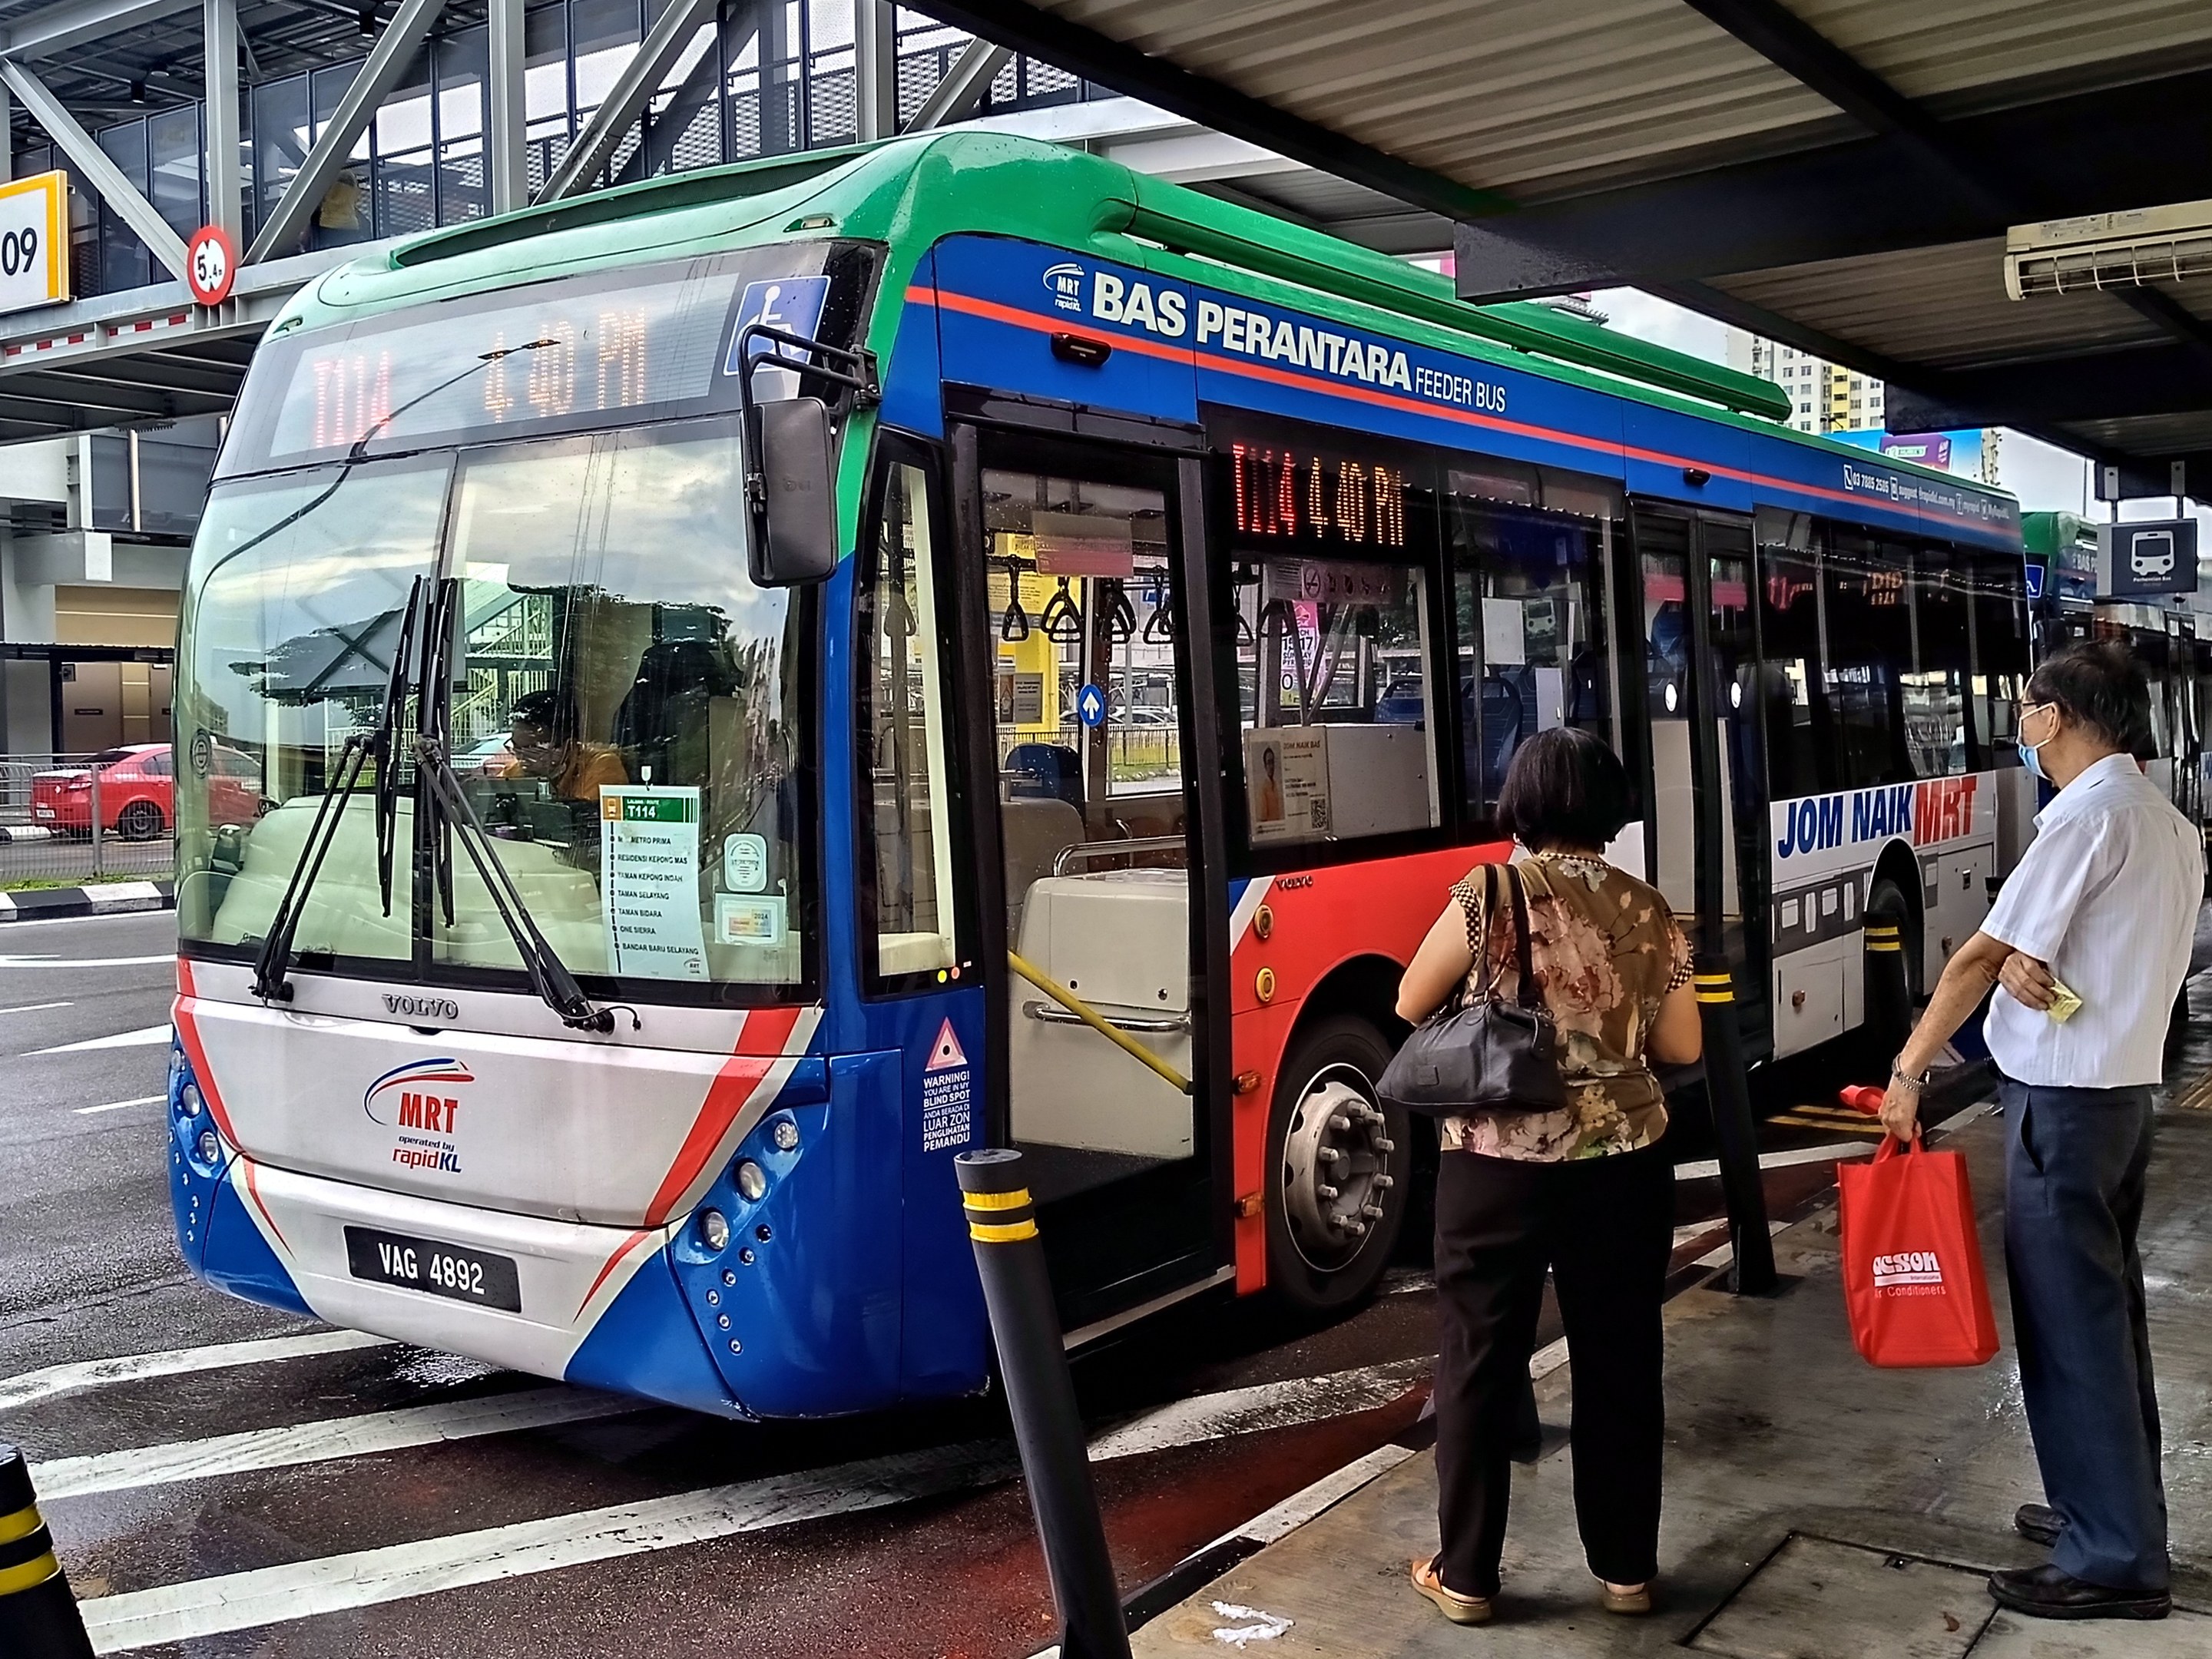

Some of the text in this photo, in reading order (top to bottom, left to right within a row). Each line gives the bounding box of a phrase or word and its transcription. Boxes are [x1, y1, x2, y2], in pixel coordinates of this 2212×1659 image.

[2, 227, 38, 276] 09
[1057, 276, 1080, 296] MRT
[1093, 271, 1506, 413] BAS PERANTARA FEEDER BUS
[313, 349, 391, 449] T114
[1233, 445, 1296, 536] T114
[627, 805, 656, 818] T114
[1777, 775, 1978, 859] JOM NAIK MRT
[631, 836, 651, 844] METRO
[652, 836, 671, 845] PRIMA
[618, 853, 688, 865] RESIDENSI KEPONG MAS
[618, 872, 683, 882] TAMAN KEPONG INDAH
[1275, 875, 1314, 892] VOLVO
[618, 889, 670, 900] TAMAN SELAYANG
[618, 908, 663, 918] TAMAN BIDARA
[633, 926, 657, 935] SIERRA
[622, 942, 699, 955] BANDAR BARU SELAYANG
[381, 993, 459, 1020] VOLVO
[923, 1071, 970, 1089] WARNING!
[923, 1088, 938, 1098] YOU
[939, 1084, 952, 1094] ARE
[952, 1083, 959, 1091] IN
[923, 1089, 971, 1108] BLIND SPOT
[399, 1091, 459, 1134] MRT
[923, 1103, 970, 1120] ANDA BERADA DI
[923, 1111, 970, 1132] LUAR ZON
[923, 1123, 970, 1141] PENGLIHATAN
[398, 1134, 455, 1152] operated by
[923, 1131, 970, 1152] PEMANDU
[392, 1147, 462, 1174] rapidKL
[378, 1242, 485, 1295] VAG 4892
[1887, 1285, 1947, 1297] Conditioners
